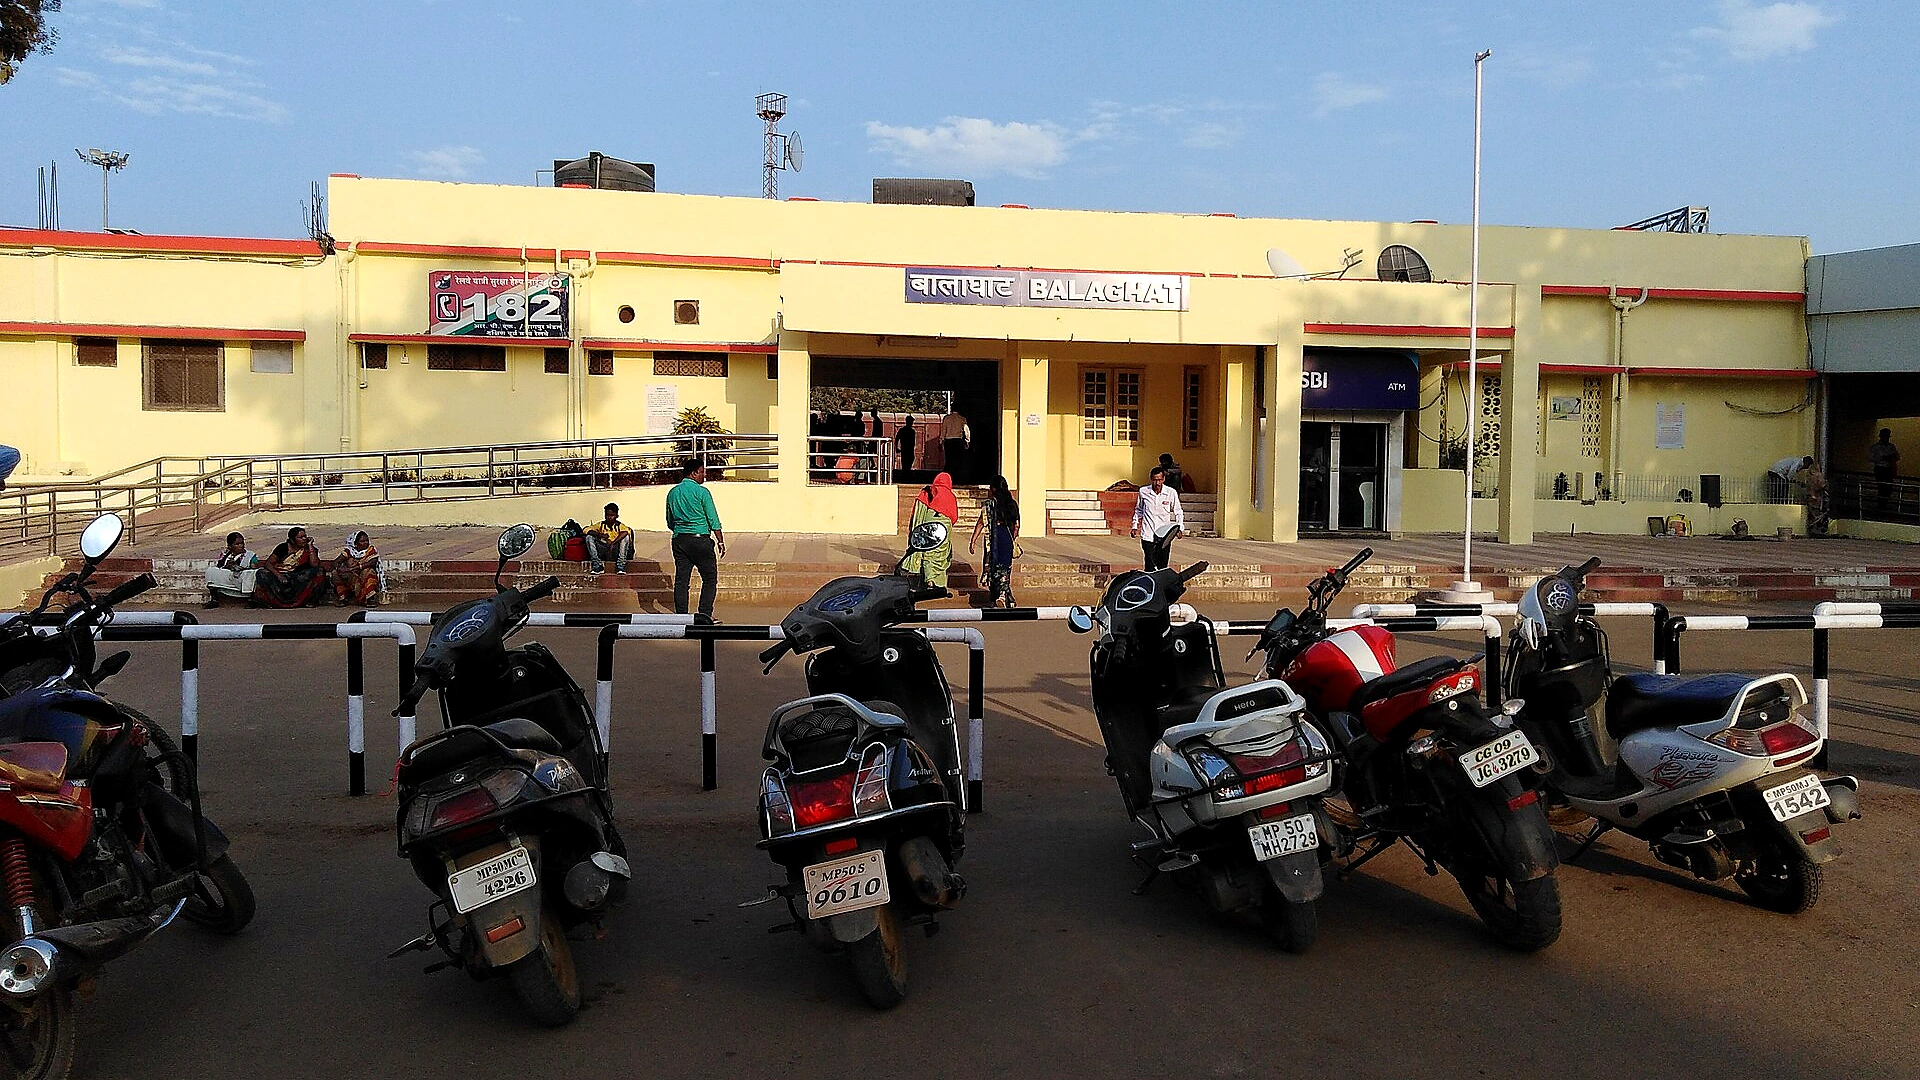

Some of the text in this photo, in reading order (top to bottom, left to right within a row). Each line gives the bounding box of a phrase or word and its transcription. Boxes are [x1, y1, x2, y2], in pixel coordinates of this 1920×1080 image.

[454, 274, 471, 285] रेलवे
[473, 275, 489, 285] यात्री
[490, 276, 508, 288] सुरक्षा
[909, 273, 1016, 299] बालाघाट
[1029, 278, 1182, 304] BALAGHAT
[462, 293, 562, 322] 182
[1301, 371, 1328, 389] SBI
[1387, 382, 1407, 391] ATM
[1234, 700, 1256, 711] Hero
[1475, 739, 1511, 763] CG 09
[1660, 745, 1719, 761] Pleasure
[1476, 747, 1531, 782] JG 3279
[1772, 779, 1810, 799] MP50MJ
[1773, 788, 1827, 818] 1542
[1262, 819, 1304, 841] MP 50
[1261, 831, 1317, 857] MH2729
[476, 855, 519, 881] MP50MC
[821, 865, 857, 883] MP50
[484, 870, 527, 898] 4226
[814, 877, 882, 910] 9610
